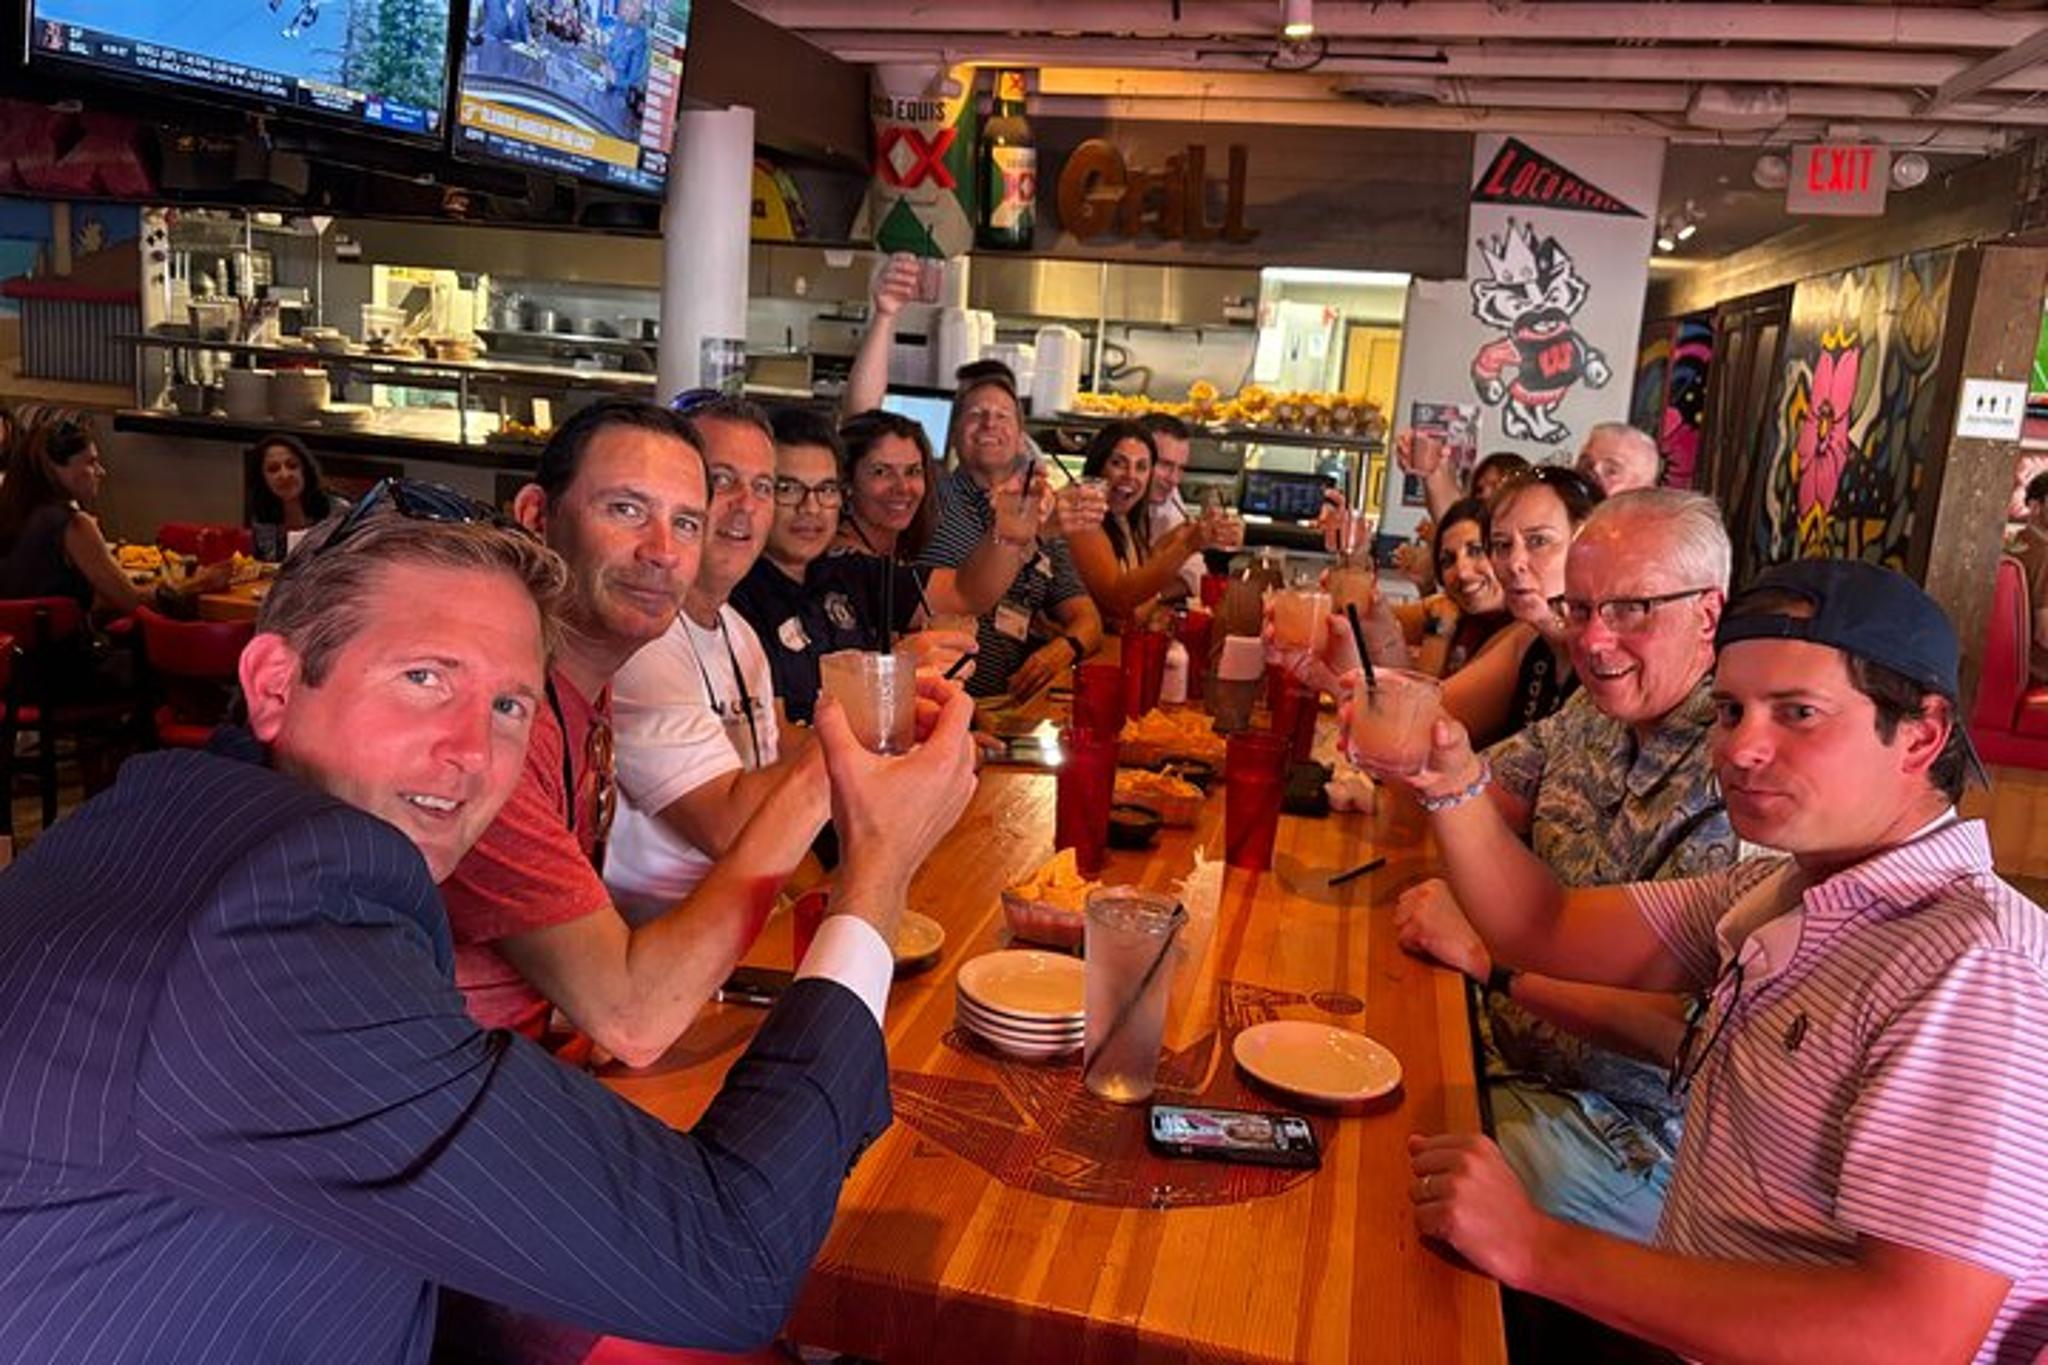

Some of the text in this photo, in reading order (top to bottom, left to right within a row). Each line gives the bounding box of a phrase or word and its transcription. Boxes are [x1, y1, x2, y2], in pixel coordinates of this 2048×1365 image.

[896, 100, 946, 122] EQUIS
[1484, 150, 1560, 200] LOCO
[1807, 146, 1874, 194] EXIT
